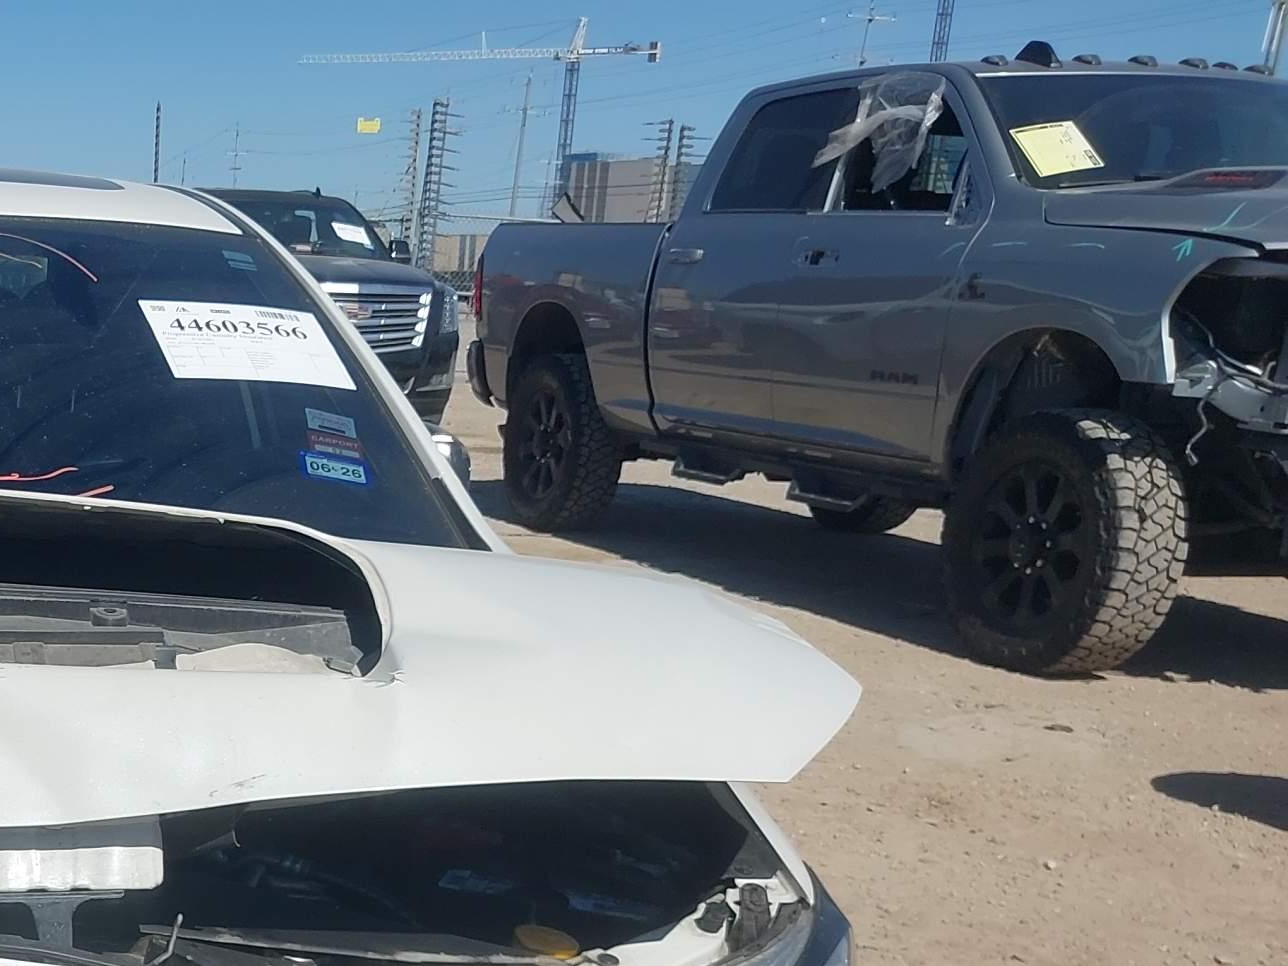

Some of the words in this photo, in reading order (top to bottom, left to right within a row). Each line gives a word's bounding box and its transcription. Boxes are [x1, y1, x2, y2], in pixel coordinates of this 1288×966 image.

[169, 318, 308, 340] 44603566
[870, 369, 918, 385] RAM
[310, 461, 331, 473] 06
[340, 466, 362, 478] 26
